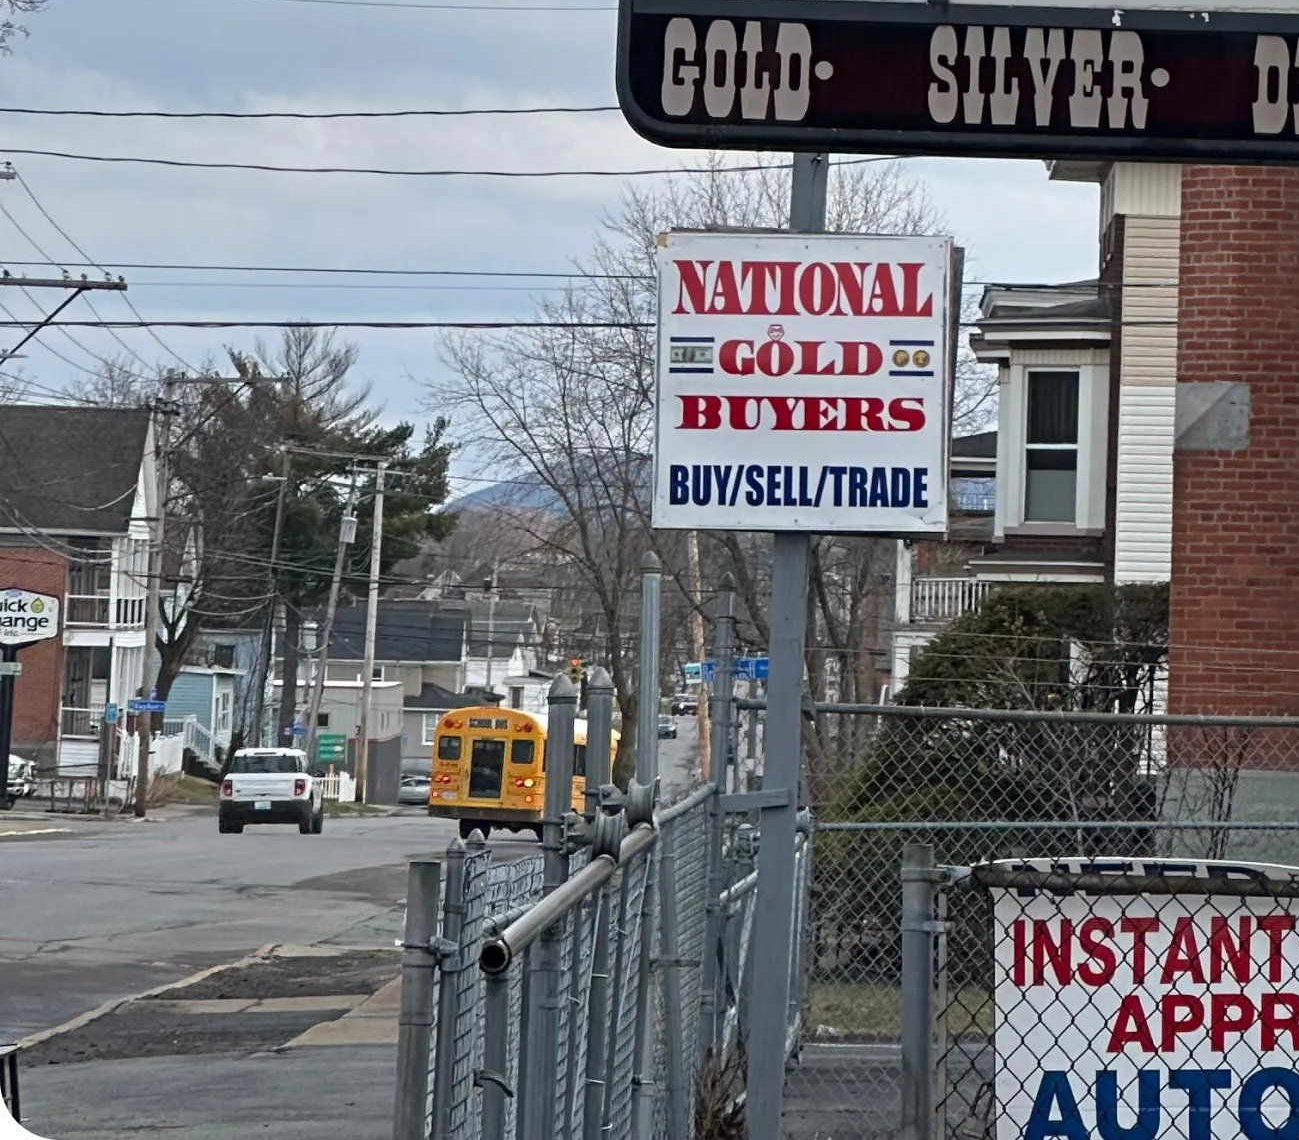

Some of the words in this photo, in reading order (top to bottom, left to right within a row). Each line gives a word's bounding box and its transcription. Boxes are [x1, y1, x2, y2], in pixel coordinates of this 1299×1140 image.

[671, 259, 934, 318] NATIONAL
[718, 339, 884, 377] GOLD
[674, 394, 926, 432] BUYERS
[669, 463, 929, 508] BUY/SELL/TRADE
[1013, 914, 1297, 987] INSTANT
